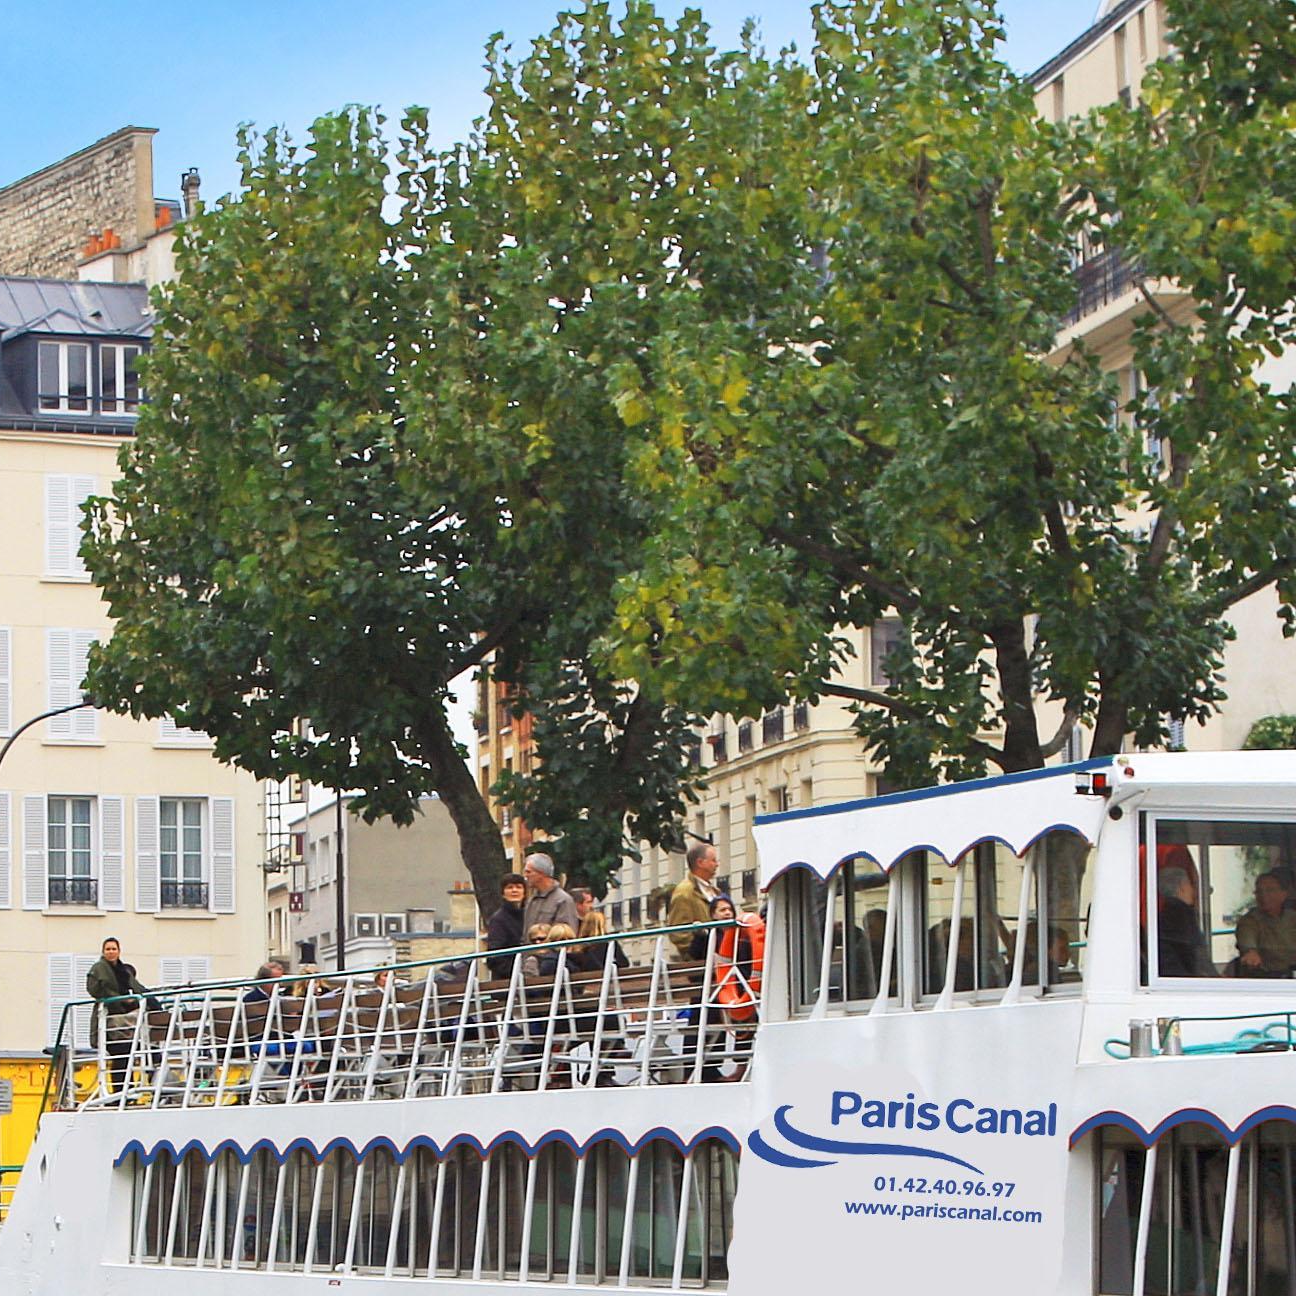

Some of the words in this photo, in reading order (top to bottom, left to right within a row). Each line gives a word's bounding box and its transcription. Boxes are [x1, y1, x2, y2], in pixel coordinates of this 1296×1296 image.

[831, 1090, 941, 1132] Paris
[944, 1098, 1058, 1137] Canal
[874, 1176, 1016, 1198] 01.42.40.96.97
[845, 1202, 1042, 1223] www.pariscanal.com
